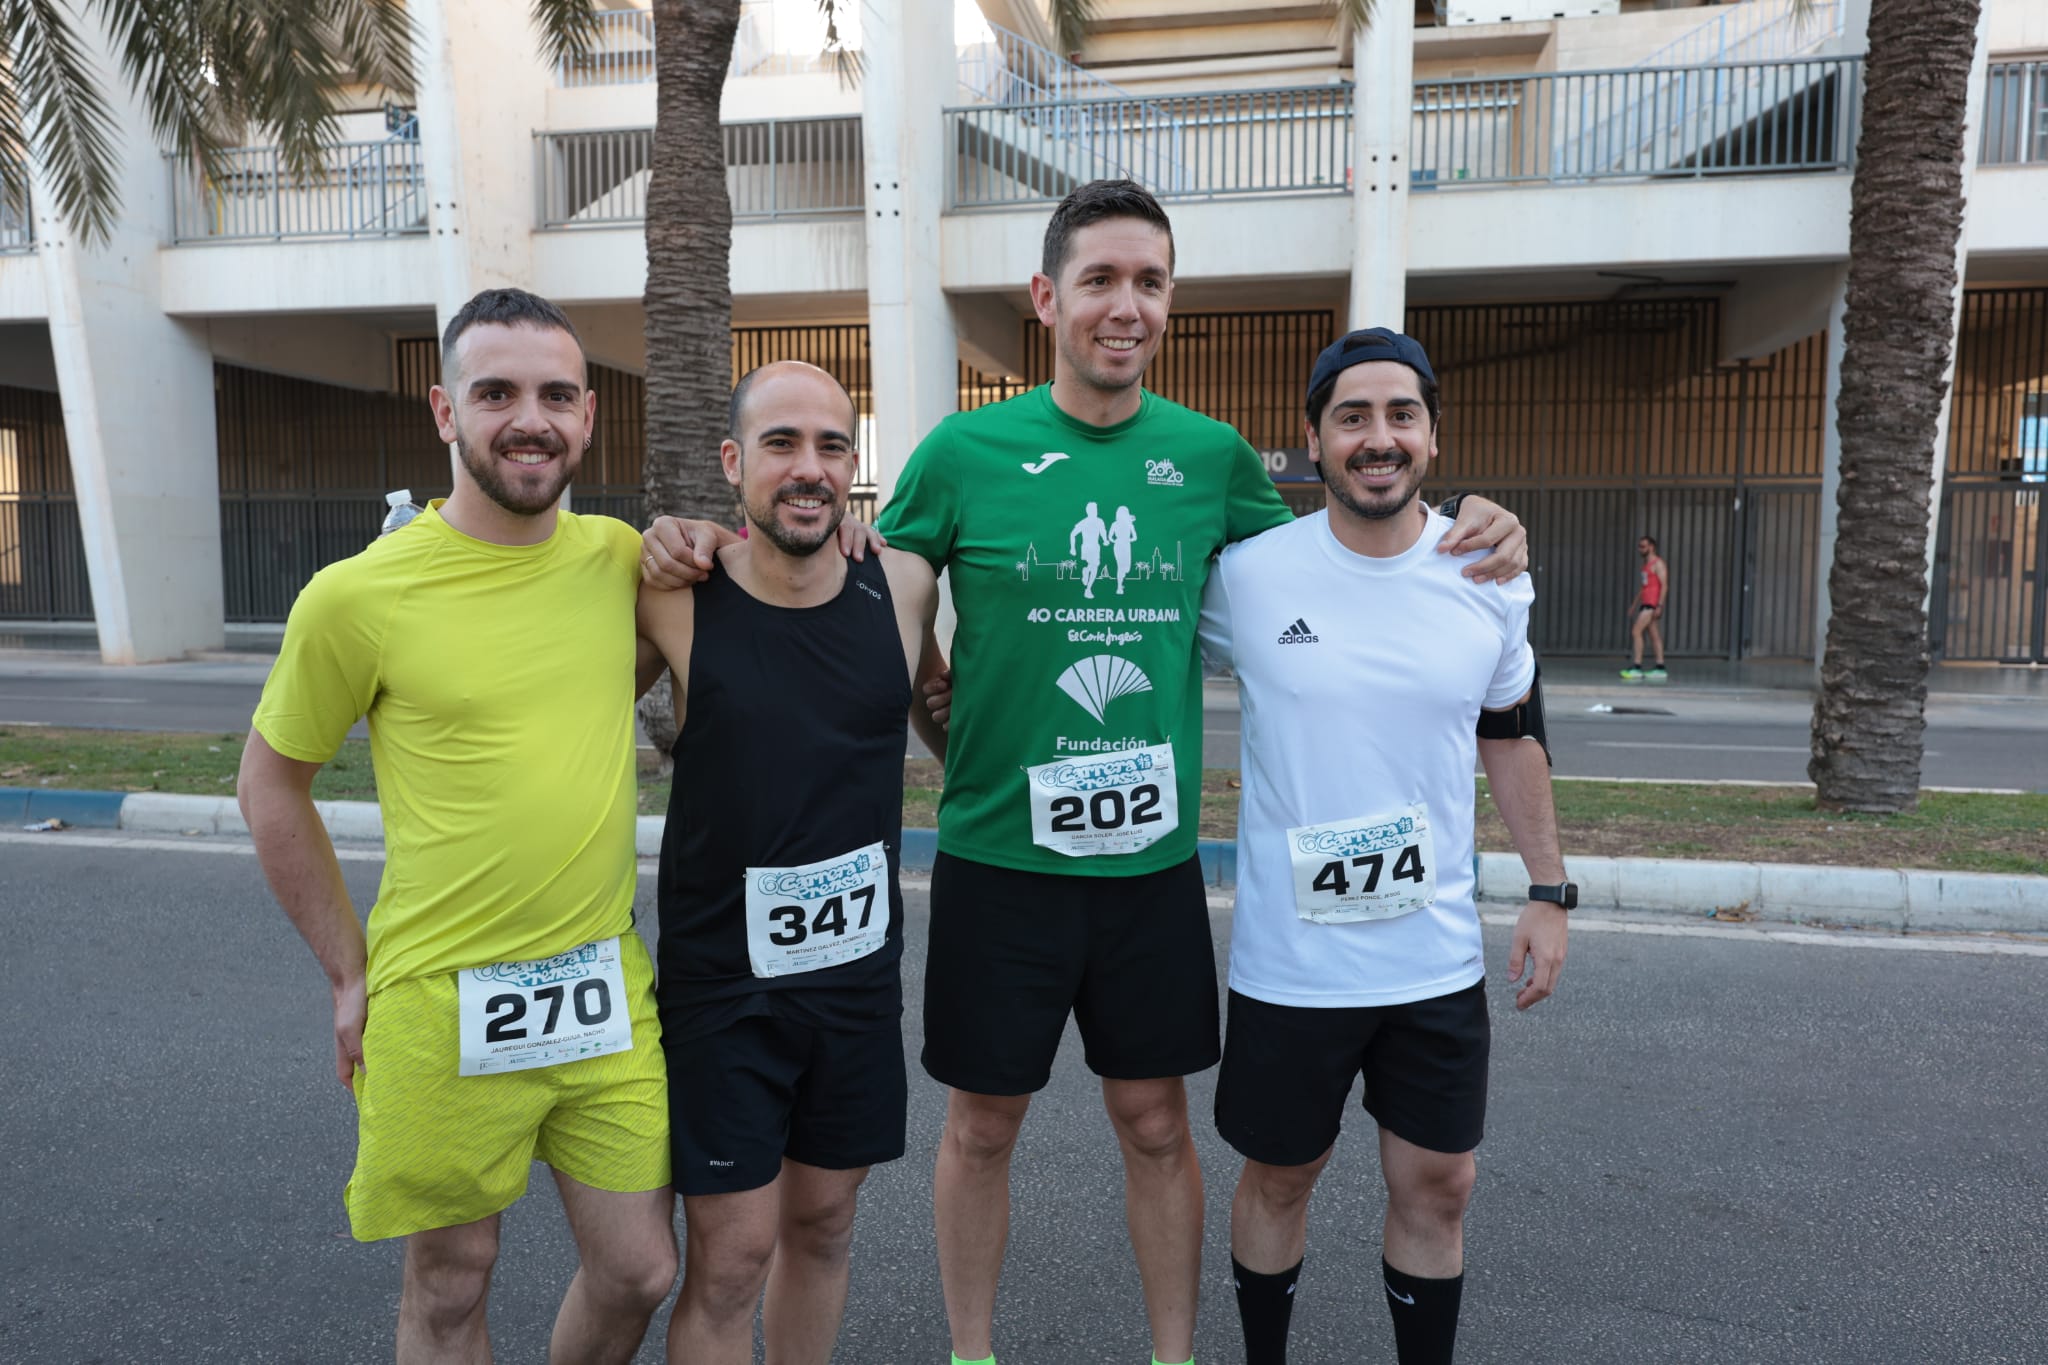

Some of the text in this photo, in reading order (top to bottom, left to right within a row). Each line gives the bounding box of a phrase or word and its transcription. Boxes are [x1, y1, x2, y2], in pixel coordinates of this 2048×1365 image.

[1145, 459, 1184, 483] 2020
[1027, 608, 1180, 622] 40 CARRERA URBANA
[1067, 626, 1143, 646] El Corte Inglés
[1277, 634, 1319, 645] adidas
[1056, 736, 1147, 751] Fundación
[1057, 759, 1139, 784] Carrera
[1075, 770, 1144, 791] Prensa
[1050, 784, 1162, 832] 202
[1316, 822, 1400, 850] Carrera
[1335, 833, 1407, 857] Prensa
[777, 862, 859, 892] Carrera
[1312, 844, 1426, 896] 474
[798, 875, 864, 900] Prensa
[769, 884, 875, 946] 347
[786, 945, 817, 955] MARTINEZ
[516, 962, 590, 987] Prensa
[486, 978, 612, 1044] 270
[491, 1043, 525, 1054] JAUREGUI
